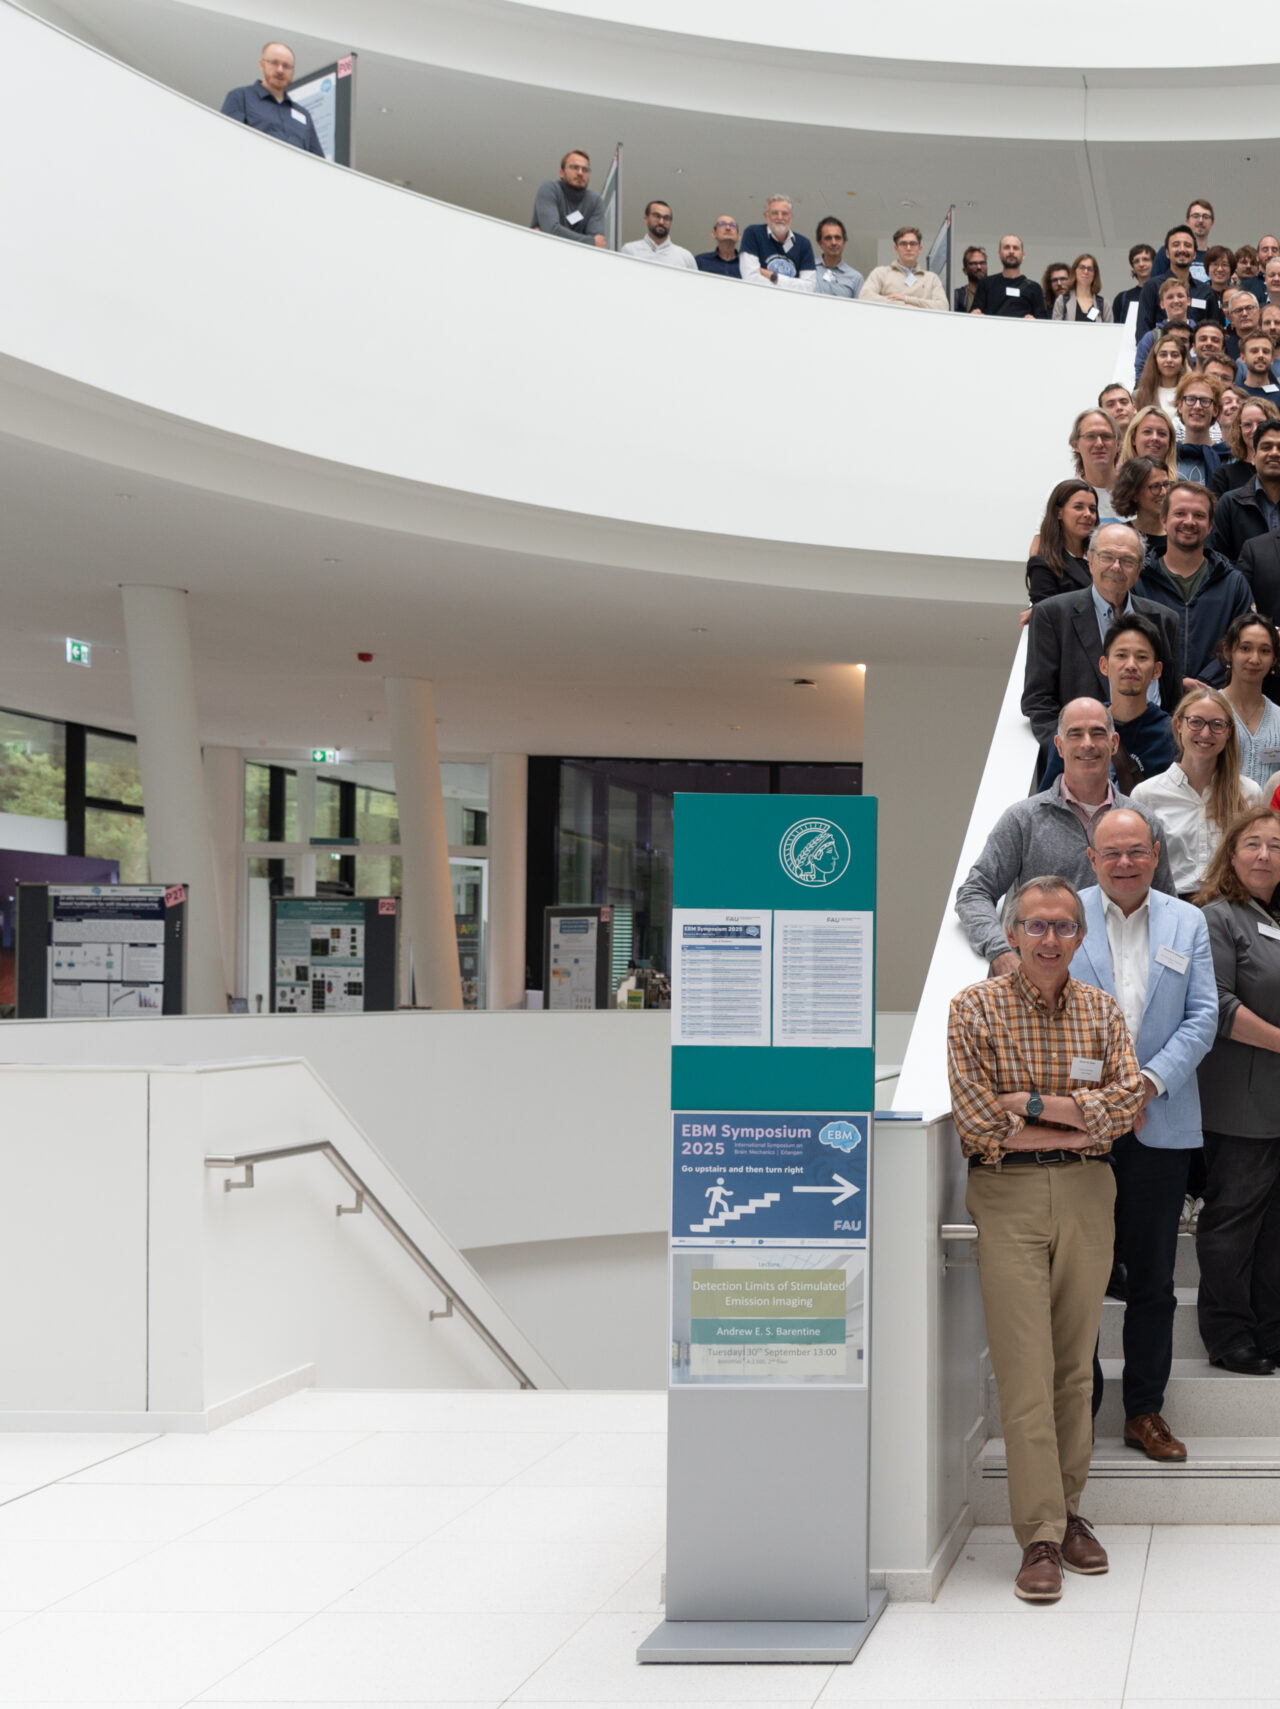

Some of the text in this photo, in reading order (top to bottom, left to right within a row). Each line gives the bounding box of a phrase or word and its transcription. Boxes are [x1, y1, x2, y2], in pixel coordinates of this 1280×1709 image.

[165, 888, 184, 904] P27
[681, 1124, 812, 1140] EBM Symposium
[827, 1130, 853, 1140] EBM
[681, 1142, 725, 1155] 2025
[681, 1165, 804, 1175] Go upstairs and then turn right
[834, 1220, 862, 1232] FAU
[692, 1280, 845, 1292] Detection Limits of Stimulated
[725, 1296, 813, 1308] Emission Imaging
[717, 1326, 821, 1337] Andrew E. S. Barentine
[765, 1347, 811, 1358] September
[813, 1347, 837, 1356] 13:00
